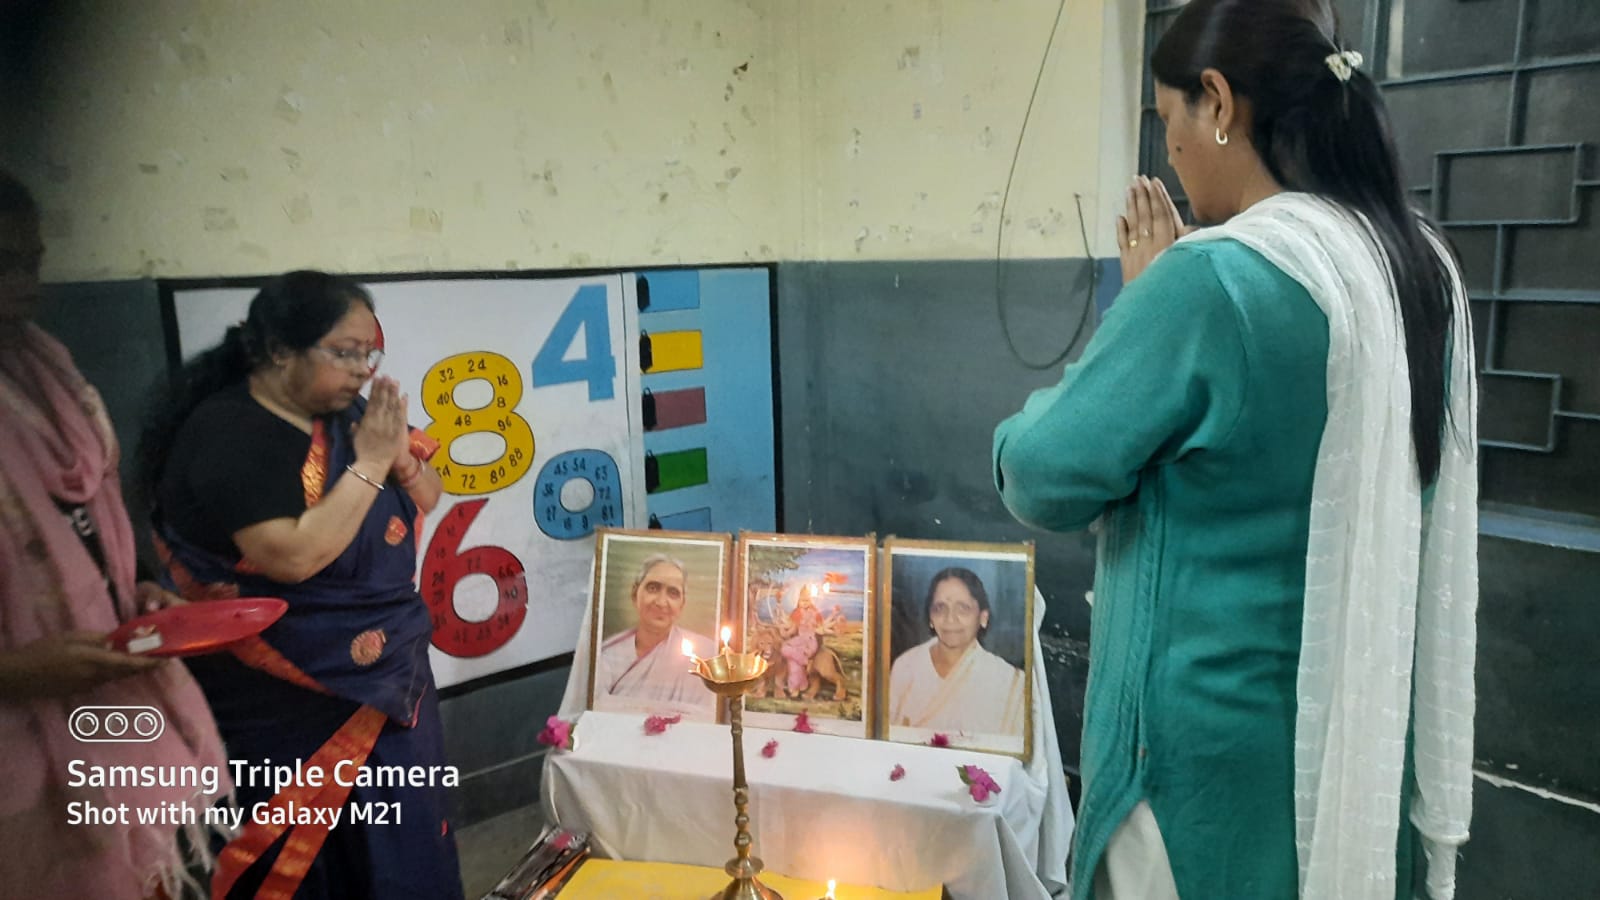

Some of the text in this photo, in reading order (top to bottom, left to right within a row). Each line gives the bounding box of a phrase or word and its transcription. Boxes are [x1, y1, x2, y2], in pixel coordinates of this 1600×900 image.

[531, 284, 617, 402] 4
[467, 359, 486, 373] 24
[439, 368, 454, 383] 32
[496, 374, 508, 386] 16
[436, 392, 450, 406] 40
[497, 397, 506, 408] 8
[421, 351, 535, 495] 8
[454, 414, 472, 427] 48
[497, 416, 512, 431] 96
[509, 448, 523, 467] 88
[461, 474, 476, 489] 72
[490, 466, 506, 484] 80
[419, 498, 529, 658] 6
